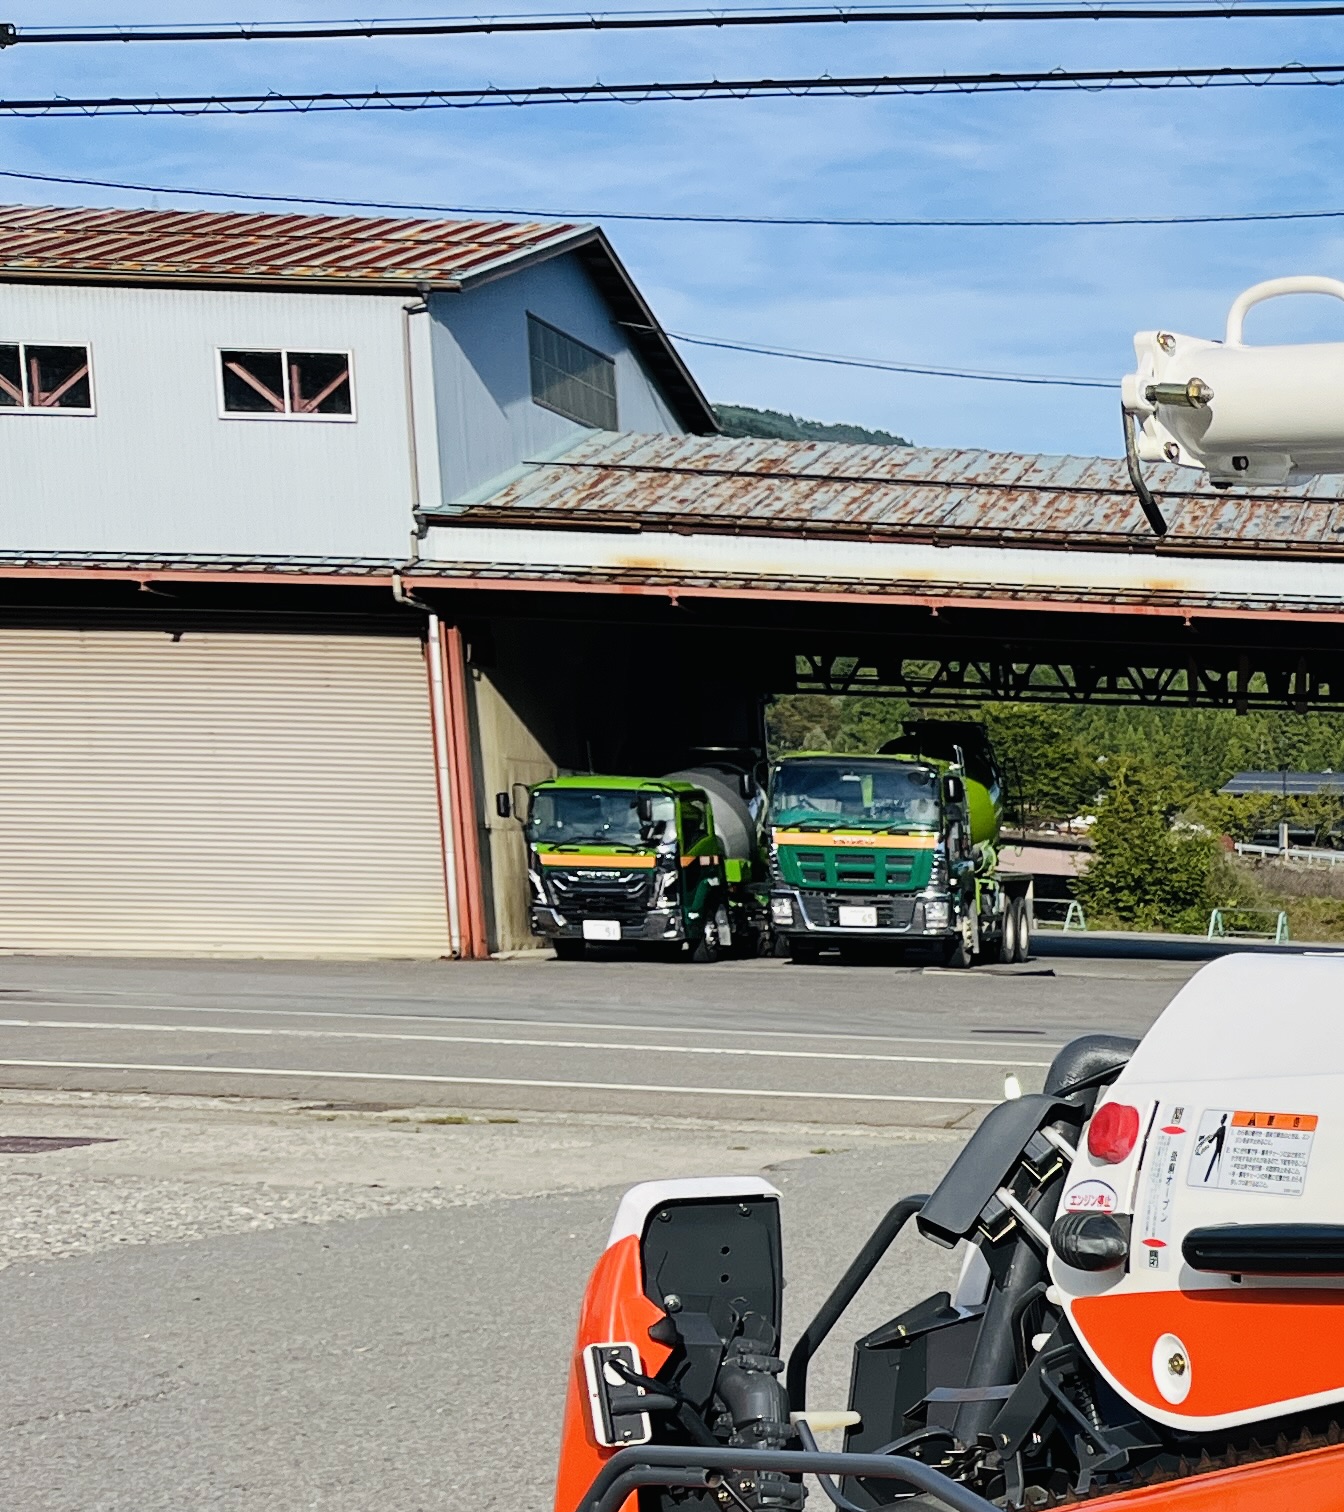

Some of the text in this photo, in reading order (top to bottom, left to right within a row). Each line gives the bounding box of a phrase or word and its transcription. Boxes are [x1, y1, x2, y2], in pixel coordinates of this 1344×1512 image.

[1070, 1195, 1111, 1208] エンジン停止
